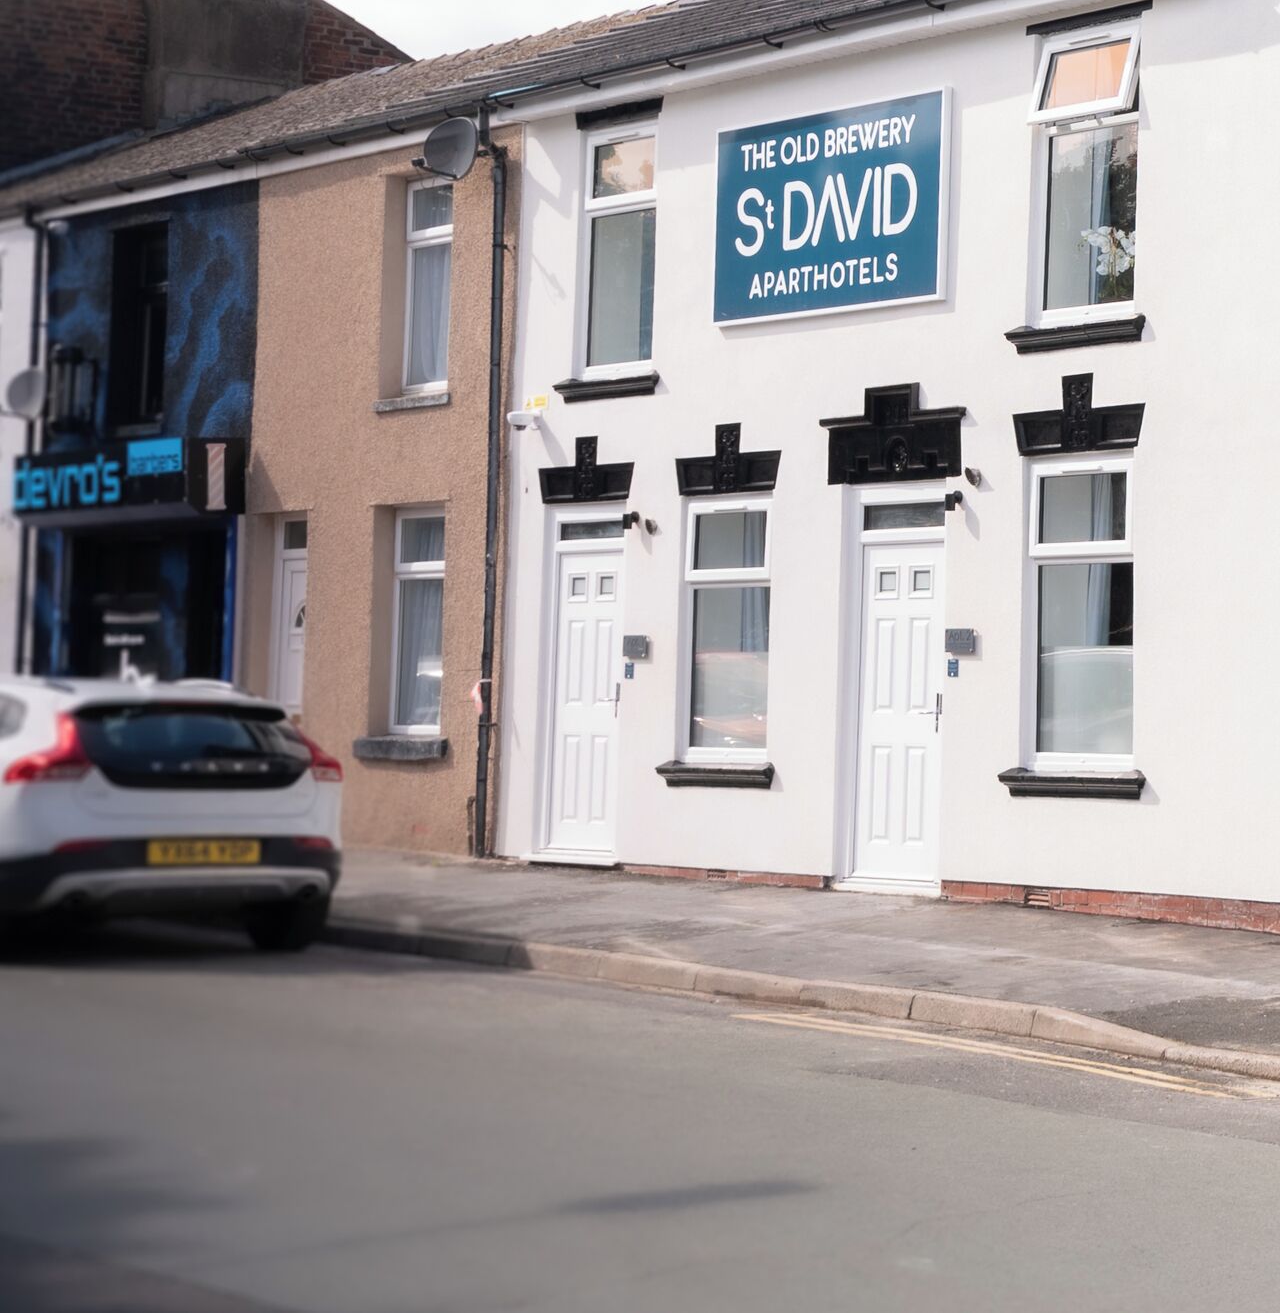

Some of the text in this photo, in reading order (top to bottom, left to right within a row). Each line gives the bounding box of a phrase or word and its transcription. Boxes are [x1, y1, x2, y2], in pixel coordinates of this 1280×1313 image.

[741, 114, 916, 172] THE OLD BREWERY
[735, 162, 918, 257] St DAVID
[749, 253, 899, 299] APARTHOTELS
[14, 453, 121, 511] devro's
